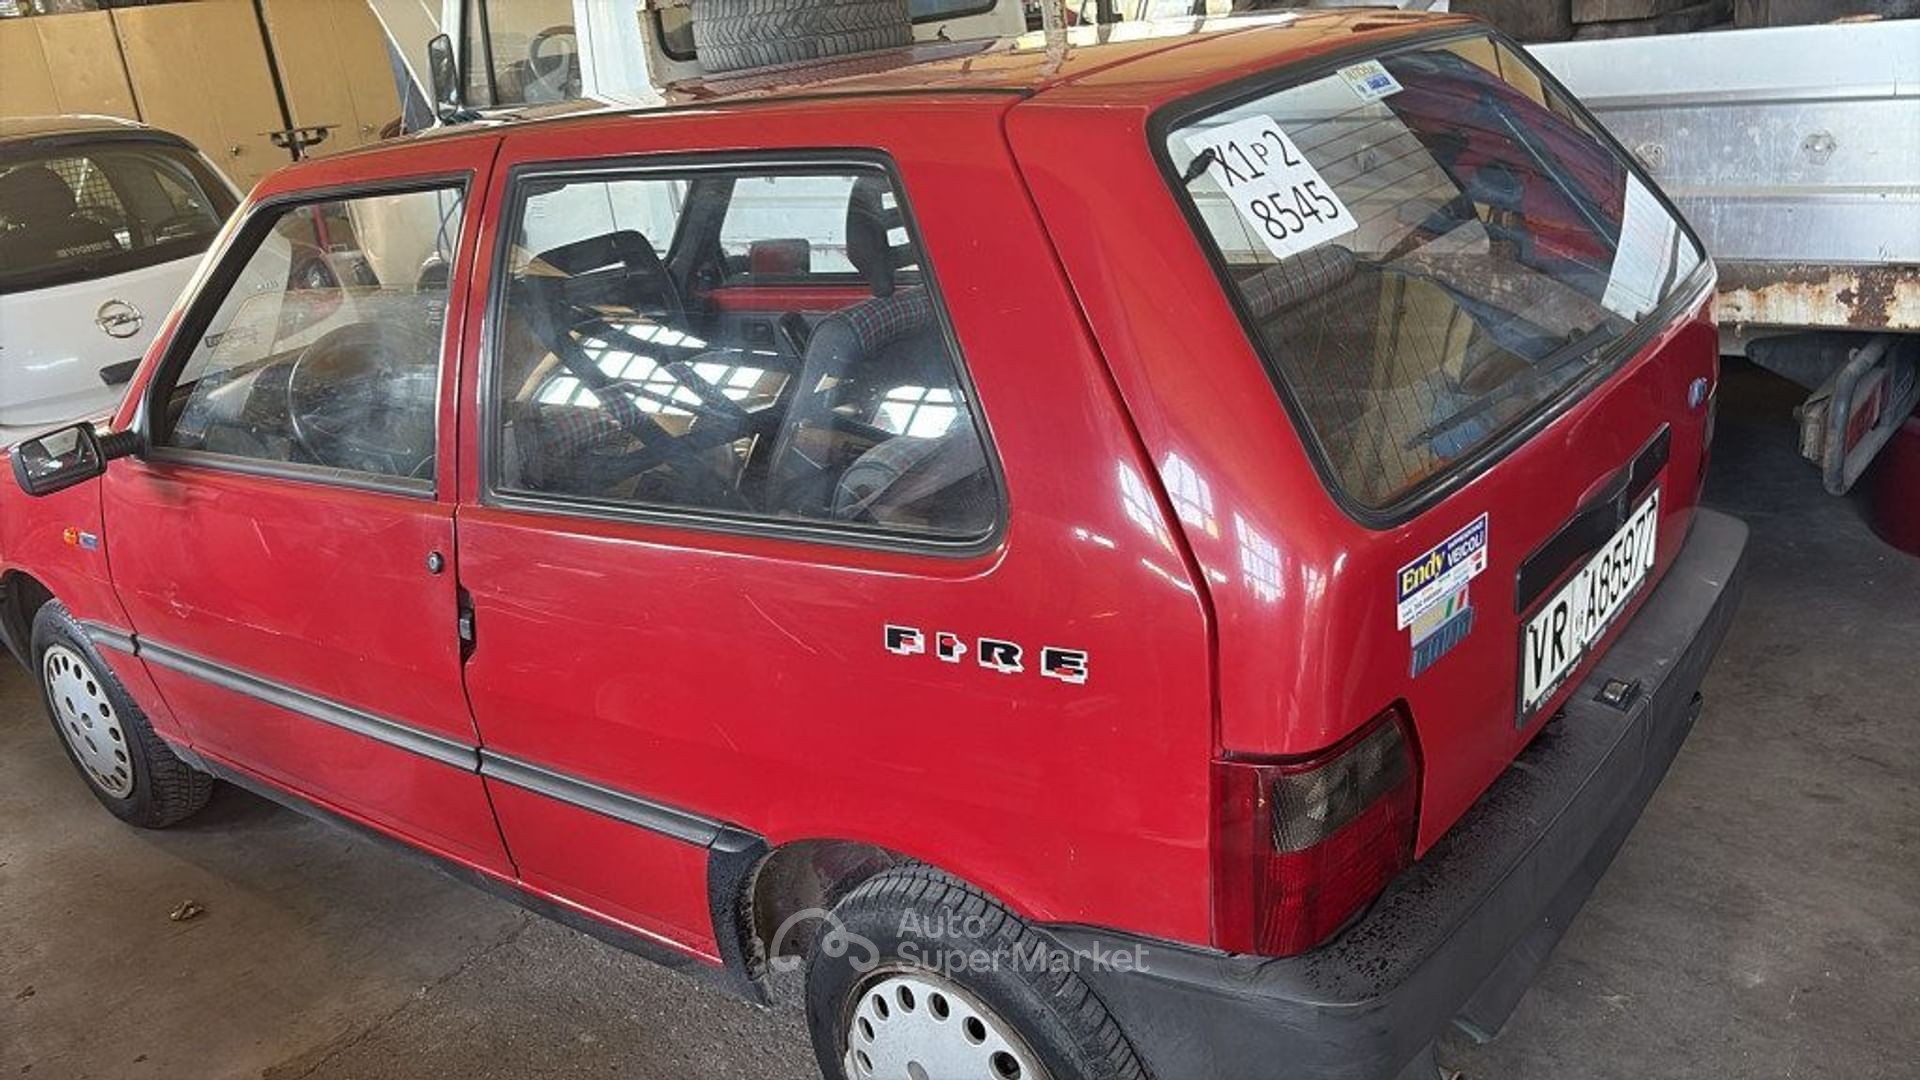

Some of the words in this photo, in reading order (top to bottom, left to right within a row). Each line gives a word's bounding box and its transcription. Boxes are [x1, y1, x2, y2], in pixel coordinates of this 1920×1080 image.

[1250, 180, 1339, 240] 8545
[1402, 550, 1446, 596] Endy
[884, 624, 1088, 685] FIRE
[1530, 600, 1568, 690] VR
